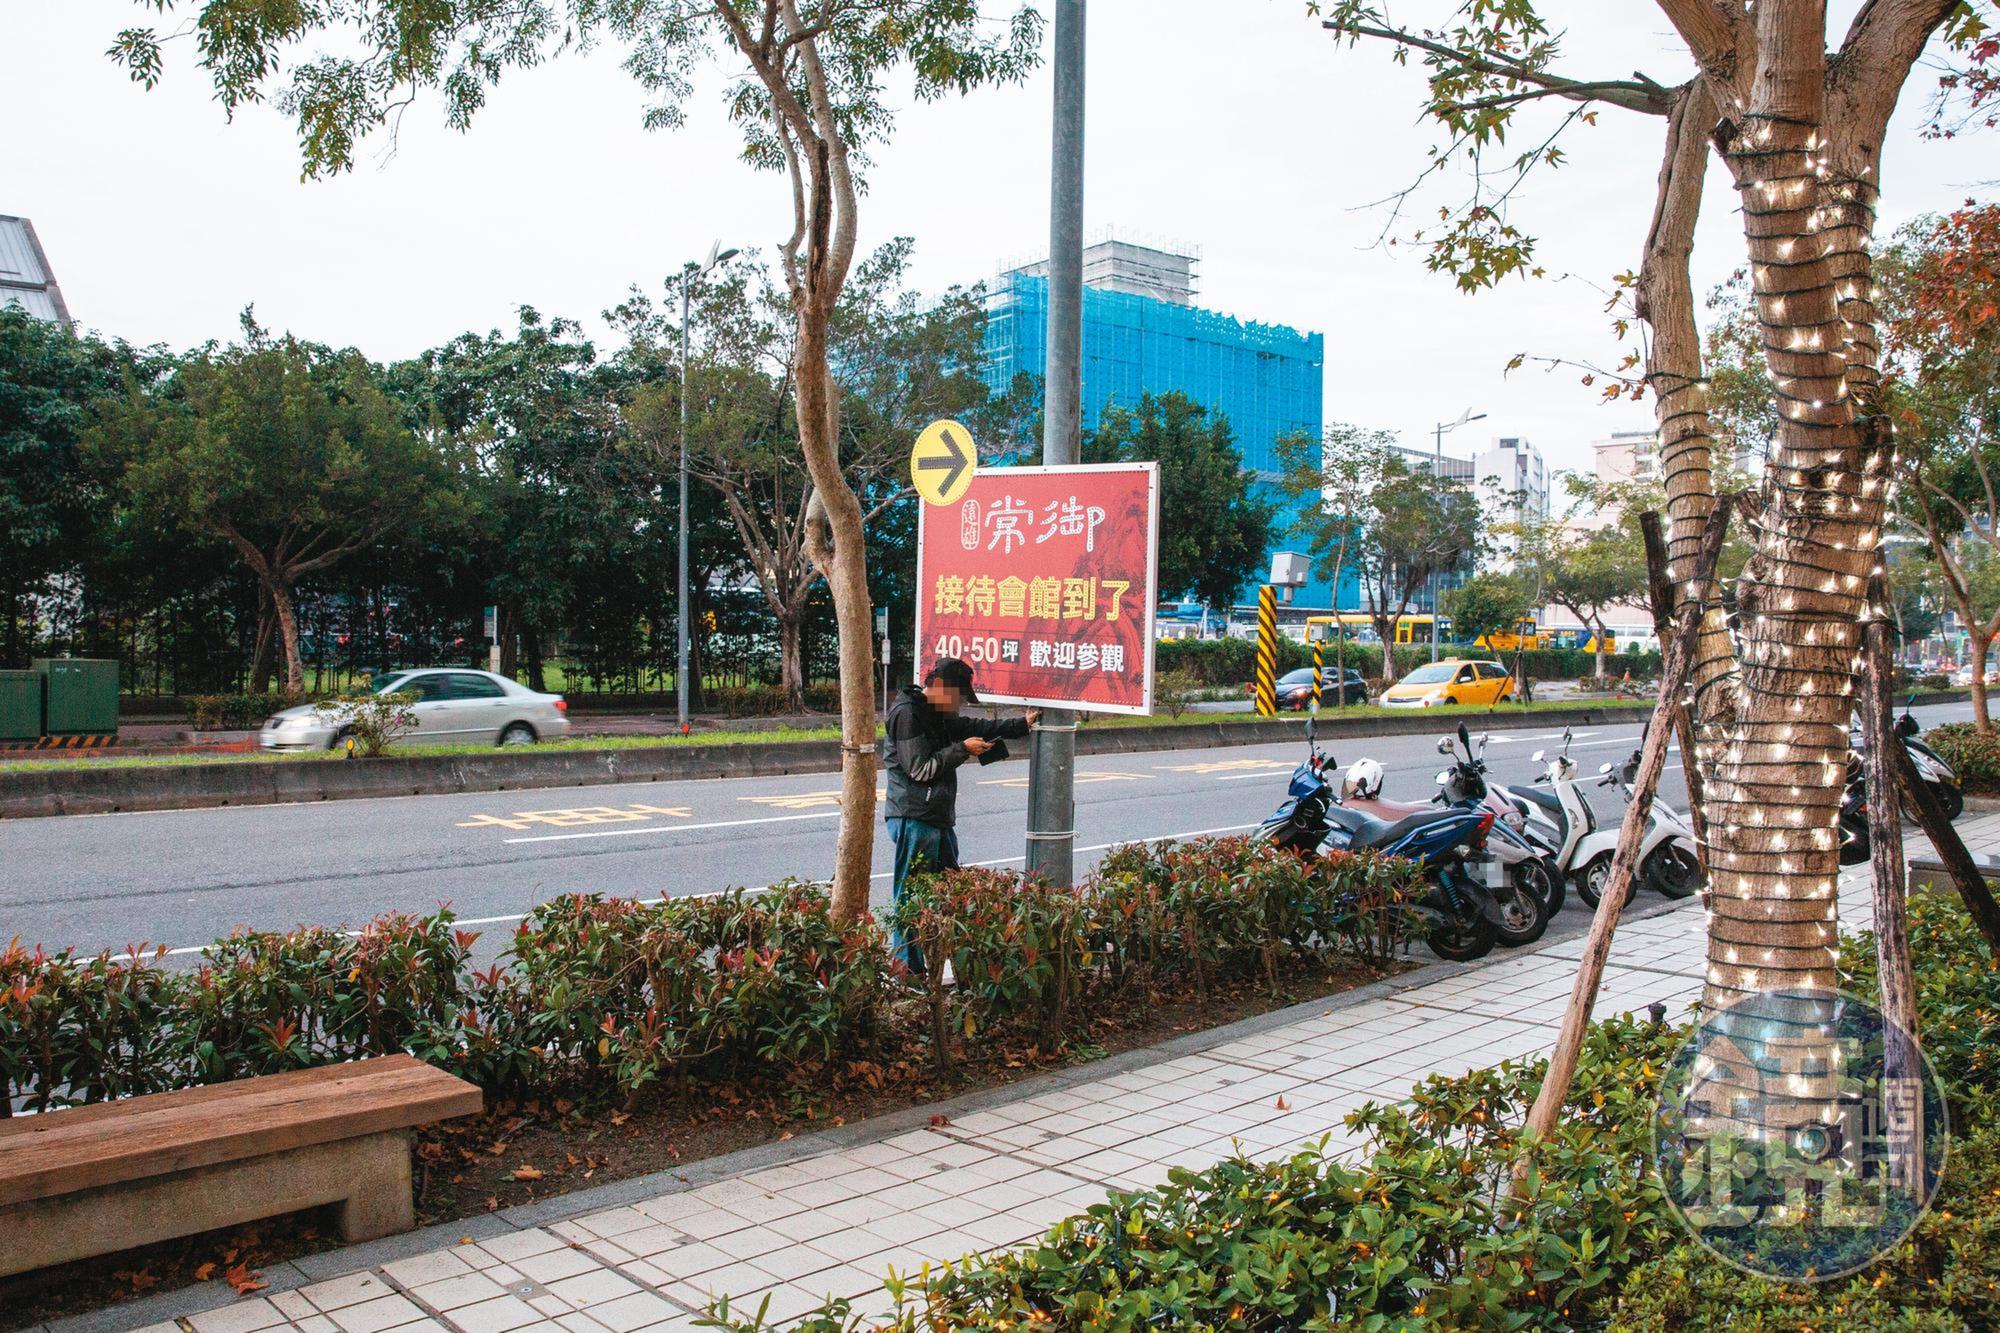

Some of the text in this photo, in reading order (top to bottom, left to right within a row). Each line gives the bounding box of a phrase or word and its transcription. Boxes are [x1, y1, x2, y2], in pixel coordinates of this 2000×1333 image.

[985, 495, 1105, 554] 常御
[935, 574, 1130, 621] 接待會館到了
[1029, 640, 1124, 673] 歡迎參觀
